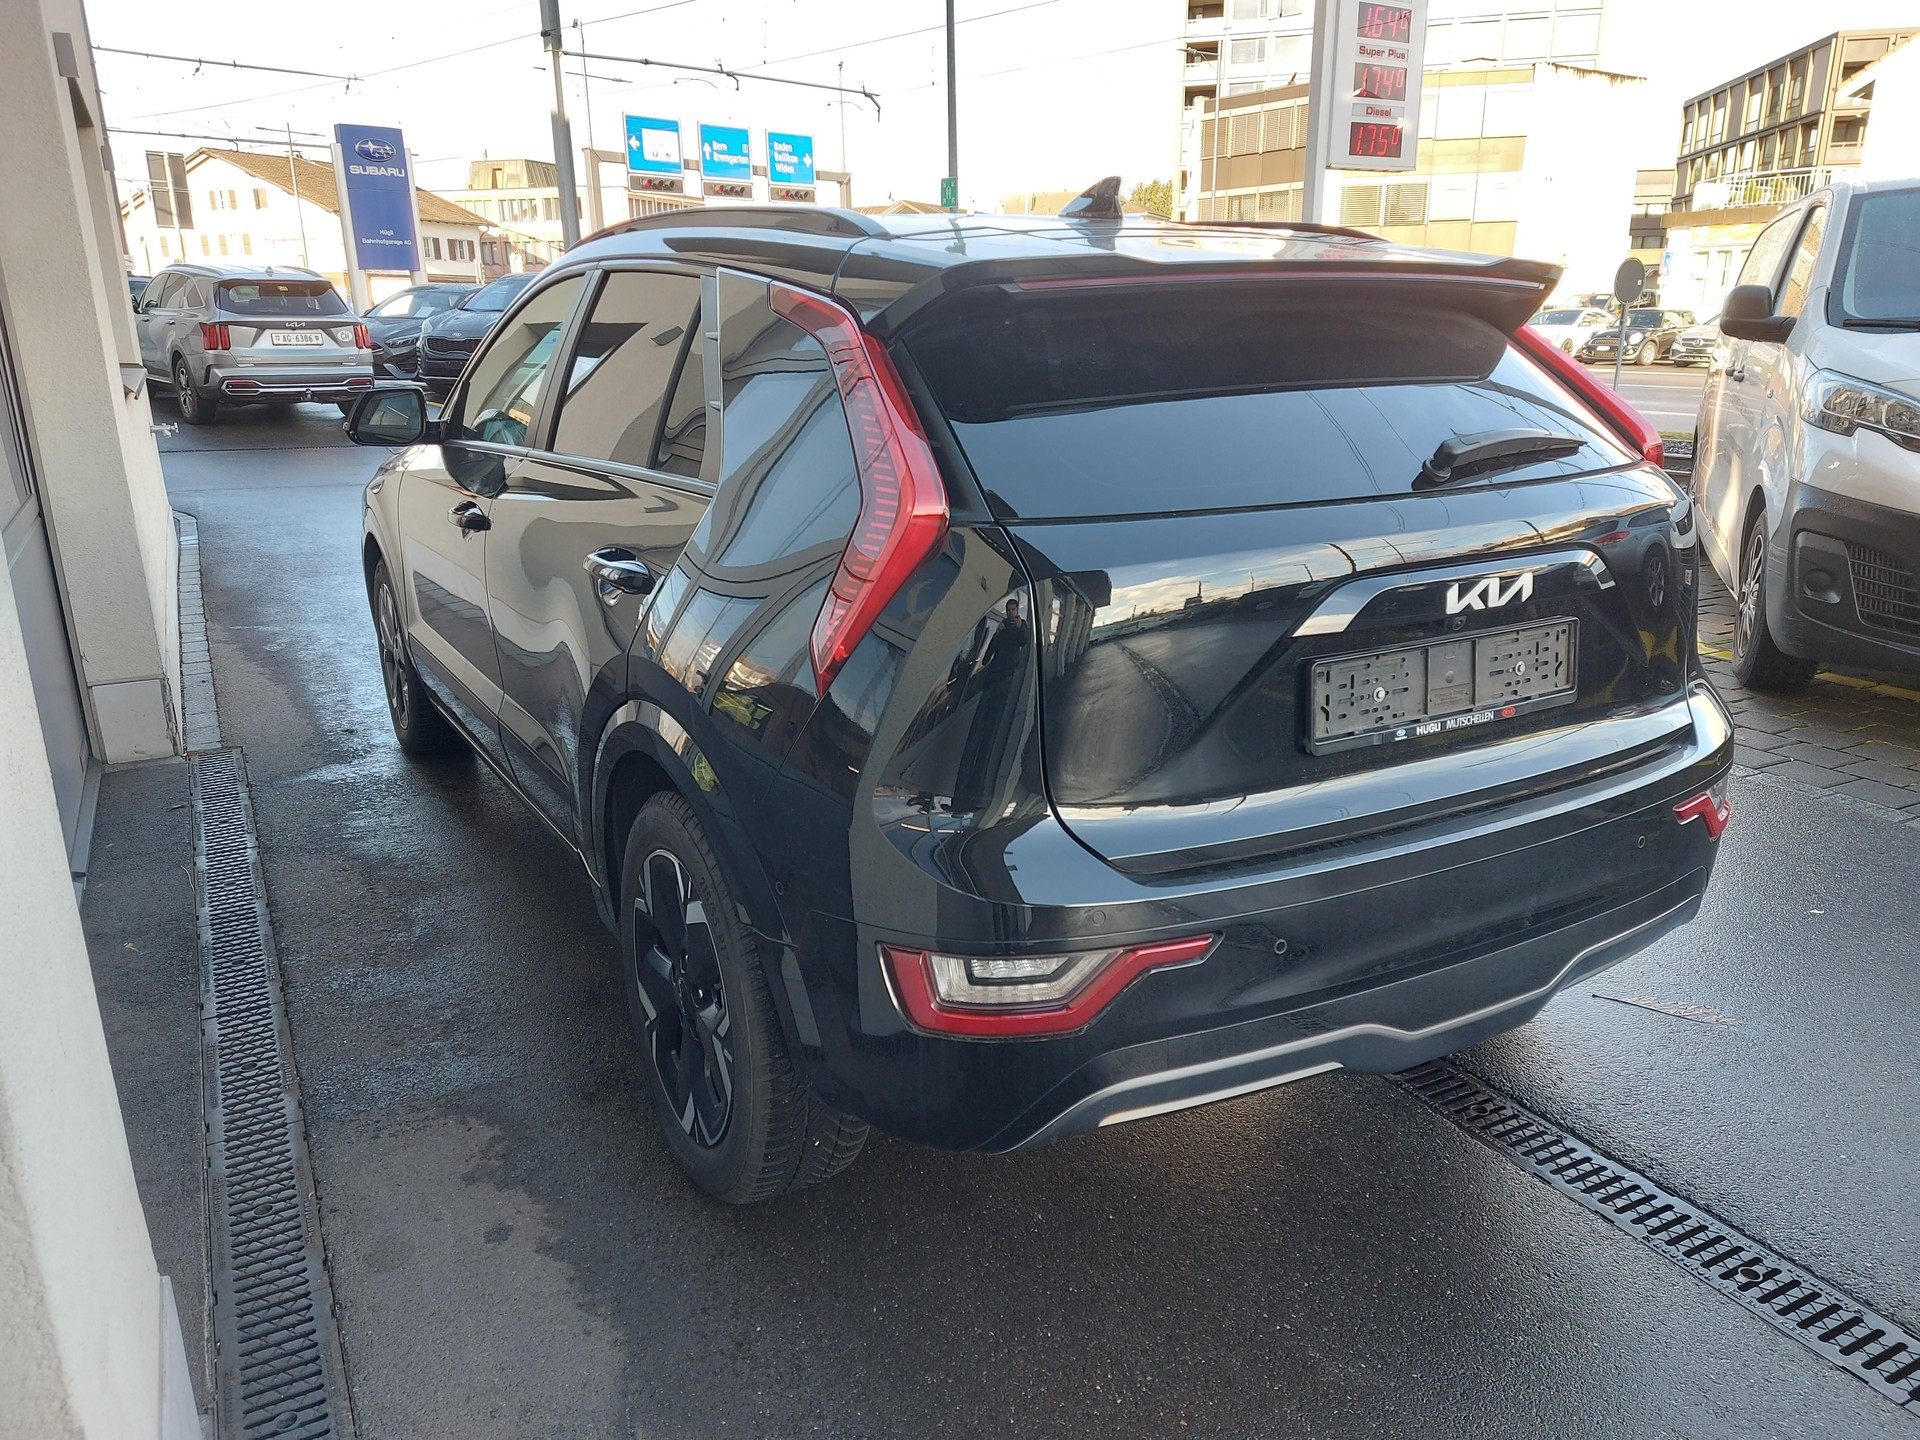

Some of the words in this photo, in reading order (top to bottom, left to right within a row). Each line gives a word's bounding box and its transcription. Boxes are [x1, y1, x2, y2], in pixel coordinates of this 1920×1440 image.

[1359, 45, 1386, 58] Super
[1388, 48, 1406, 59] Plus
[1366, 106, 1392, 117] Diesel
[713, 141, 728, 151] Bern
[774, 141, 793, 152] Baden
[349, 165, 405, 177] SUBARU
[361, 238, 403, 246] Bahnhofgarage
[340, 332, 350, 340] CH
[1446, 572, 1534, 615] KIA
[1446, 711, 1494, 730] MUTSCHELLEN
